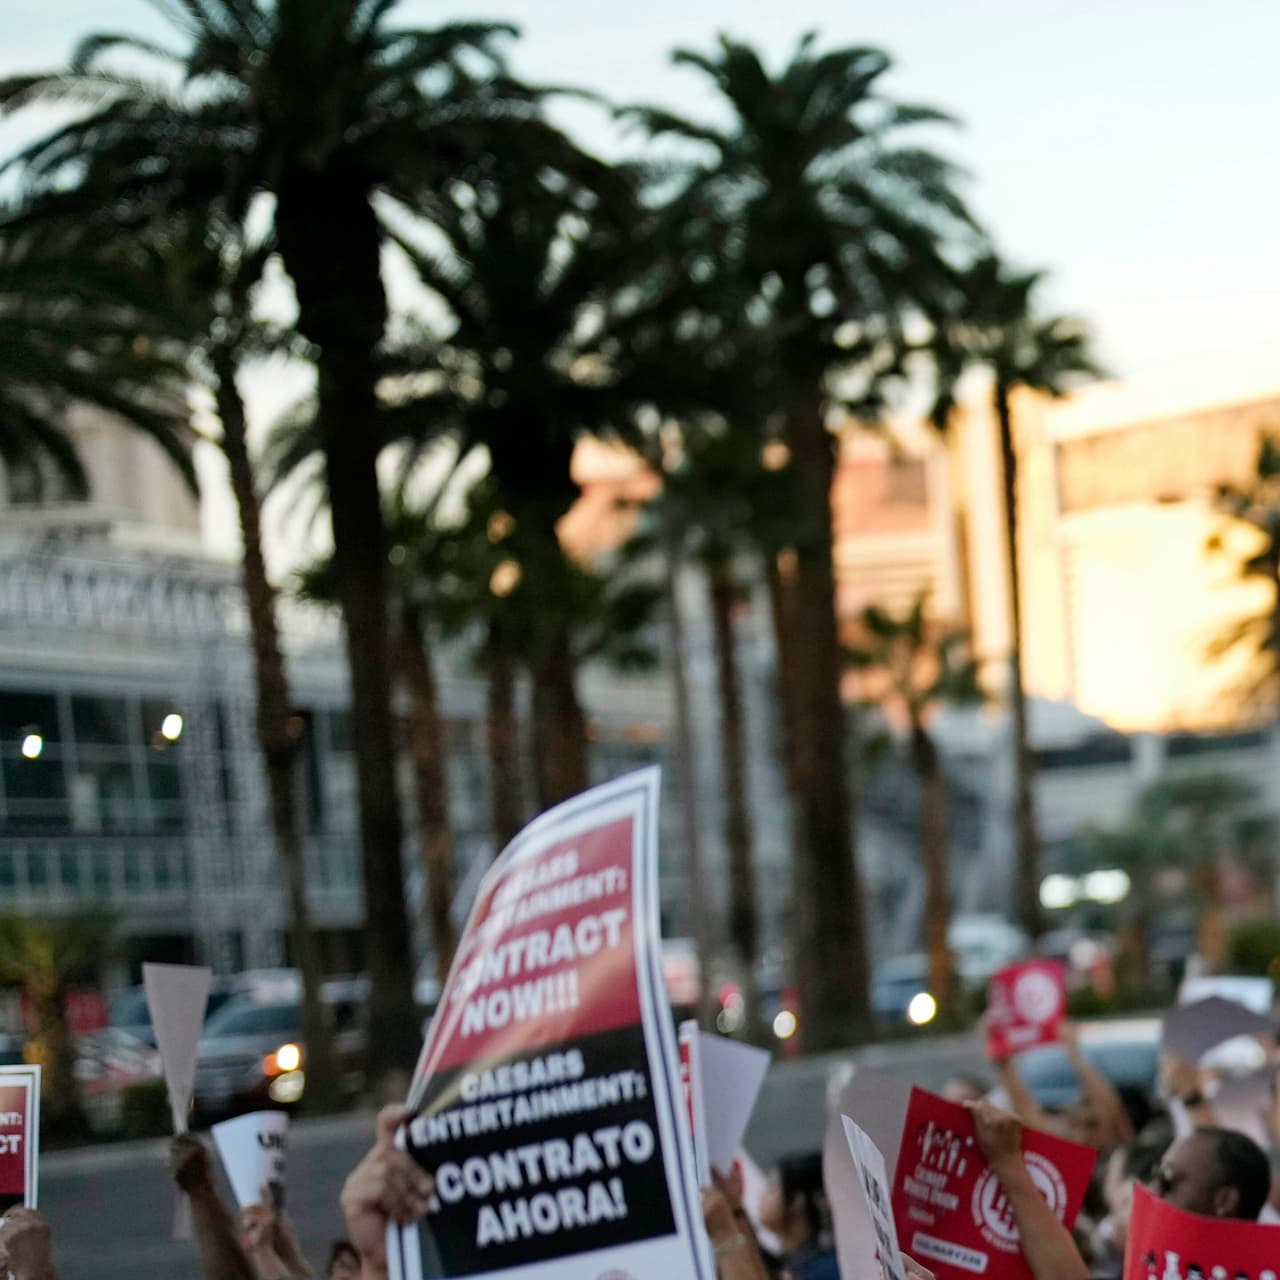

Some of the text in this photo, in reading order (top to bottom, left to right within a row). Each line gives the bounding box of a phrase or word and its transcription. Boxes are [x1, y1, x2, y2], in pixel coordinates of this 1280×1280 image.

[460, 969, 579, 1039] NOW!!!
[408, 1068, 648, 1149] ENTERTAINMENT:
[460, 1048, 586, 1101] CAESARS
[475, 1175, 629, 1249] AHORA!
